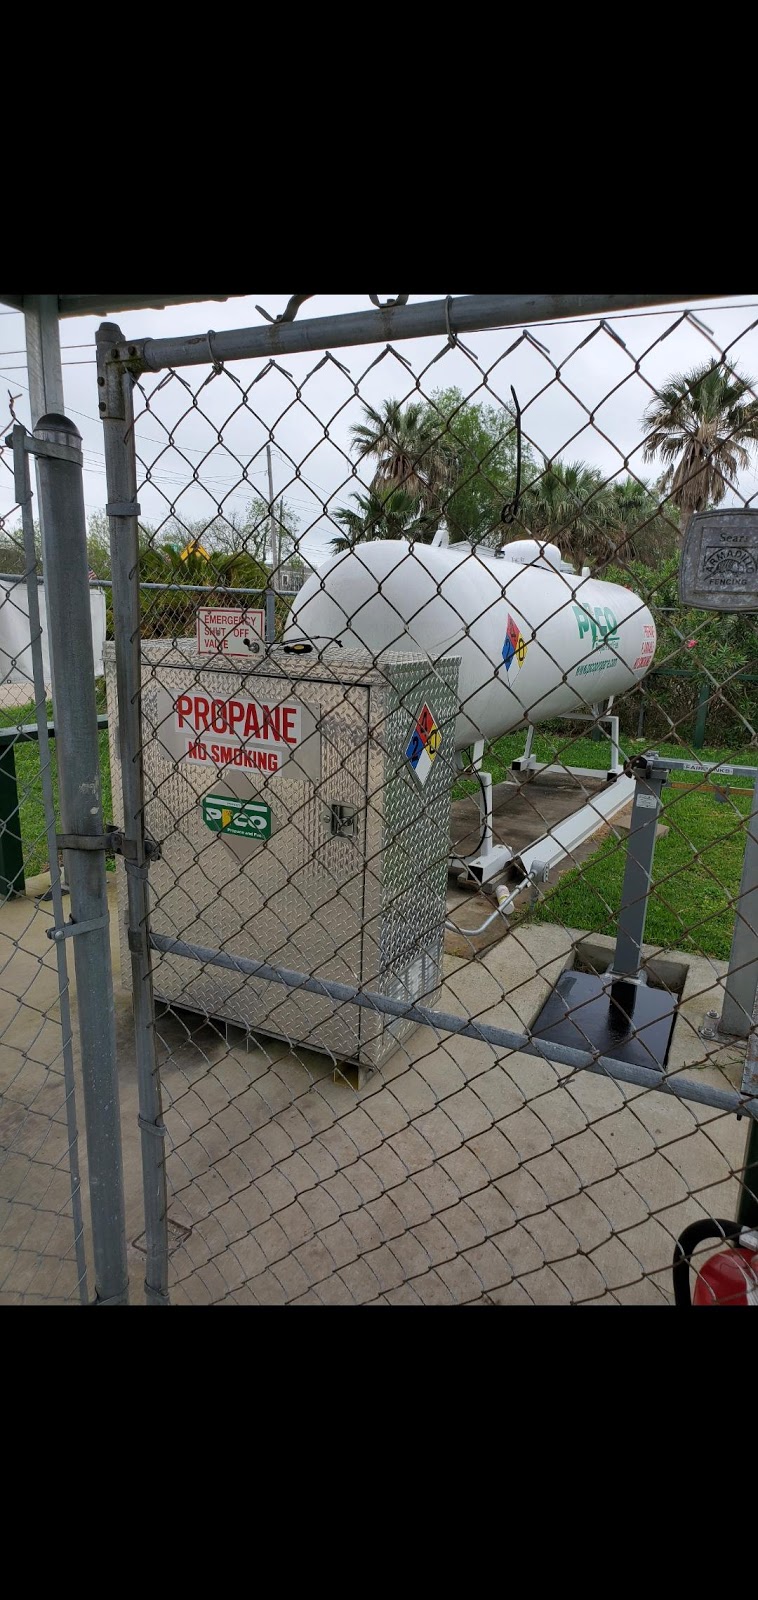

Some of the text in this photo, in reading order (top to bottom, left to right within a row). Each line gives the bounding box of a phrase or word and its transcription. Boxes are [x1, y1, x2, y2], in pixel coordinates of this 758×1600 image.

[720, 532, 749, 542] Sears
[705, 549, 755, 574] ARMADILLO
[204, 614, 257, 626] EMERGENCY
[204, 627, 250, 638] SHUT OFF
[204, 638, 229, 649] VALE
[176, 694, 298, 744] PROPANE
[188, 741, 279, 772] NO SMOKING
[411, 736, 419, 763] 2
